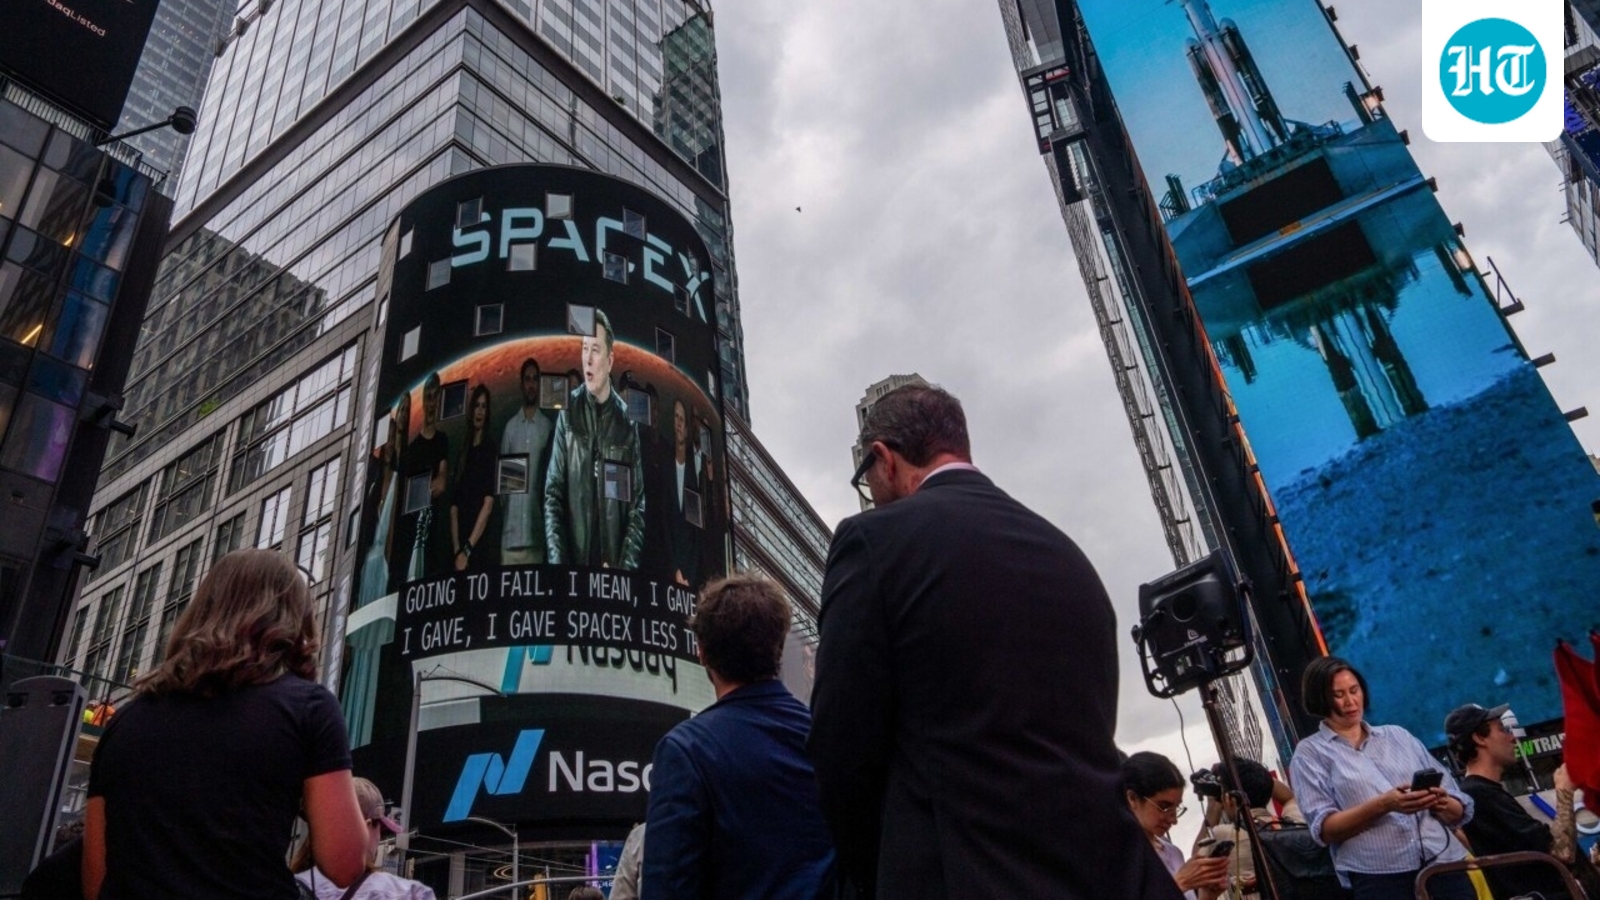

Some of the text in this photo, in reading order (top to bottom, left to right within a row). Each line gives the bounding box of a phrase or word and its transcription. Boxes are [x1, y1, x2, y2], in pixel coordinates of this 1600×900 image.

[452, 207, 710, 324] SPACEX
[405, 569, 698, 617] GOING TO FAIL. I MEAN, I GAVE
[402, 627, 412, 655] I
[421, 617, 472, 650] GAVE,
[487, 613, 497, 641] I
[509, 610, 556, 639] GAVE
[567, 610, 632, 642] SPACEX
[641, 618, 678, 651] LESS
[1514, 733, 1566, 758] EWTRA
[548, 750, 653, 793] Nas
